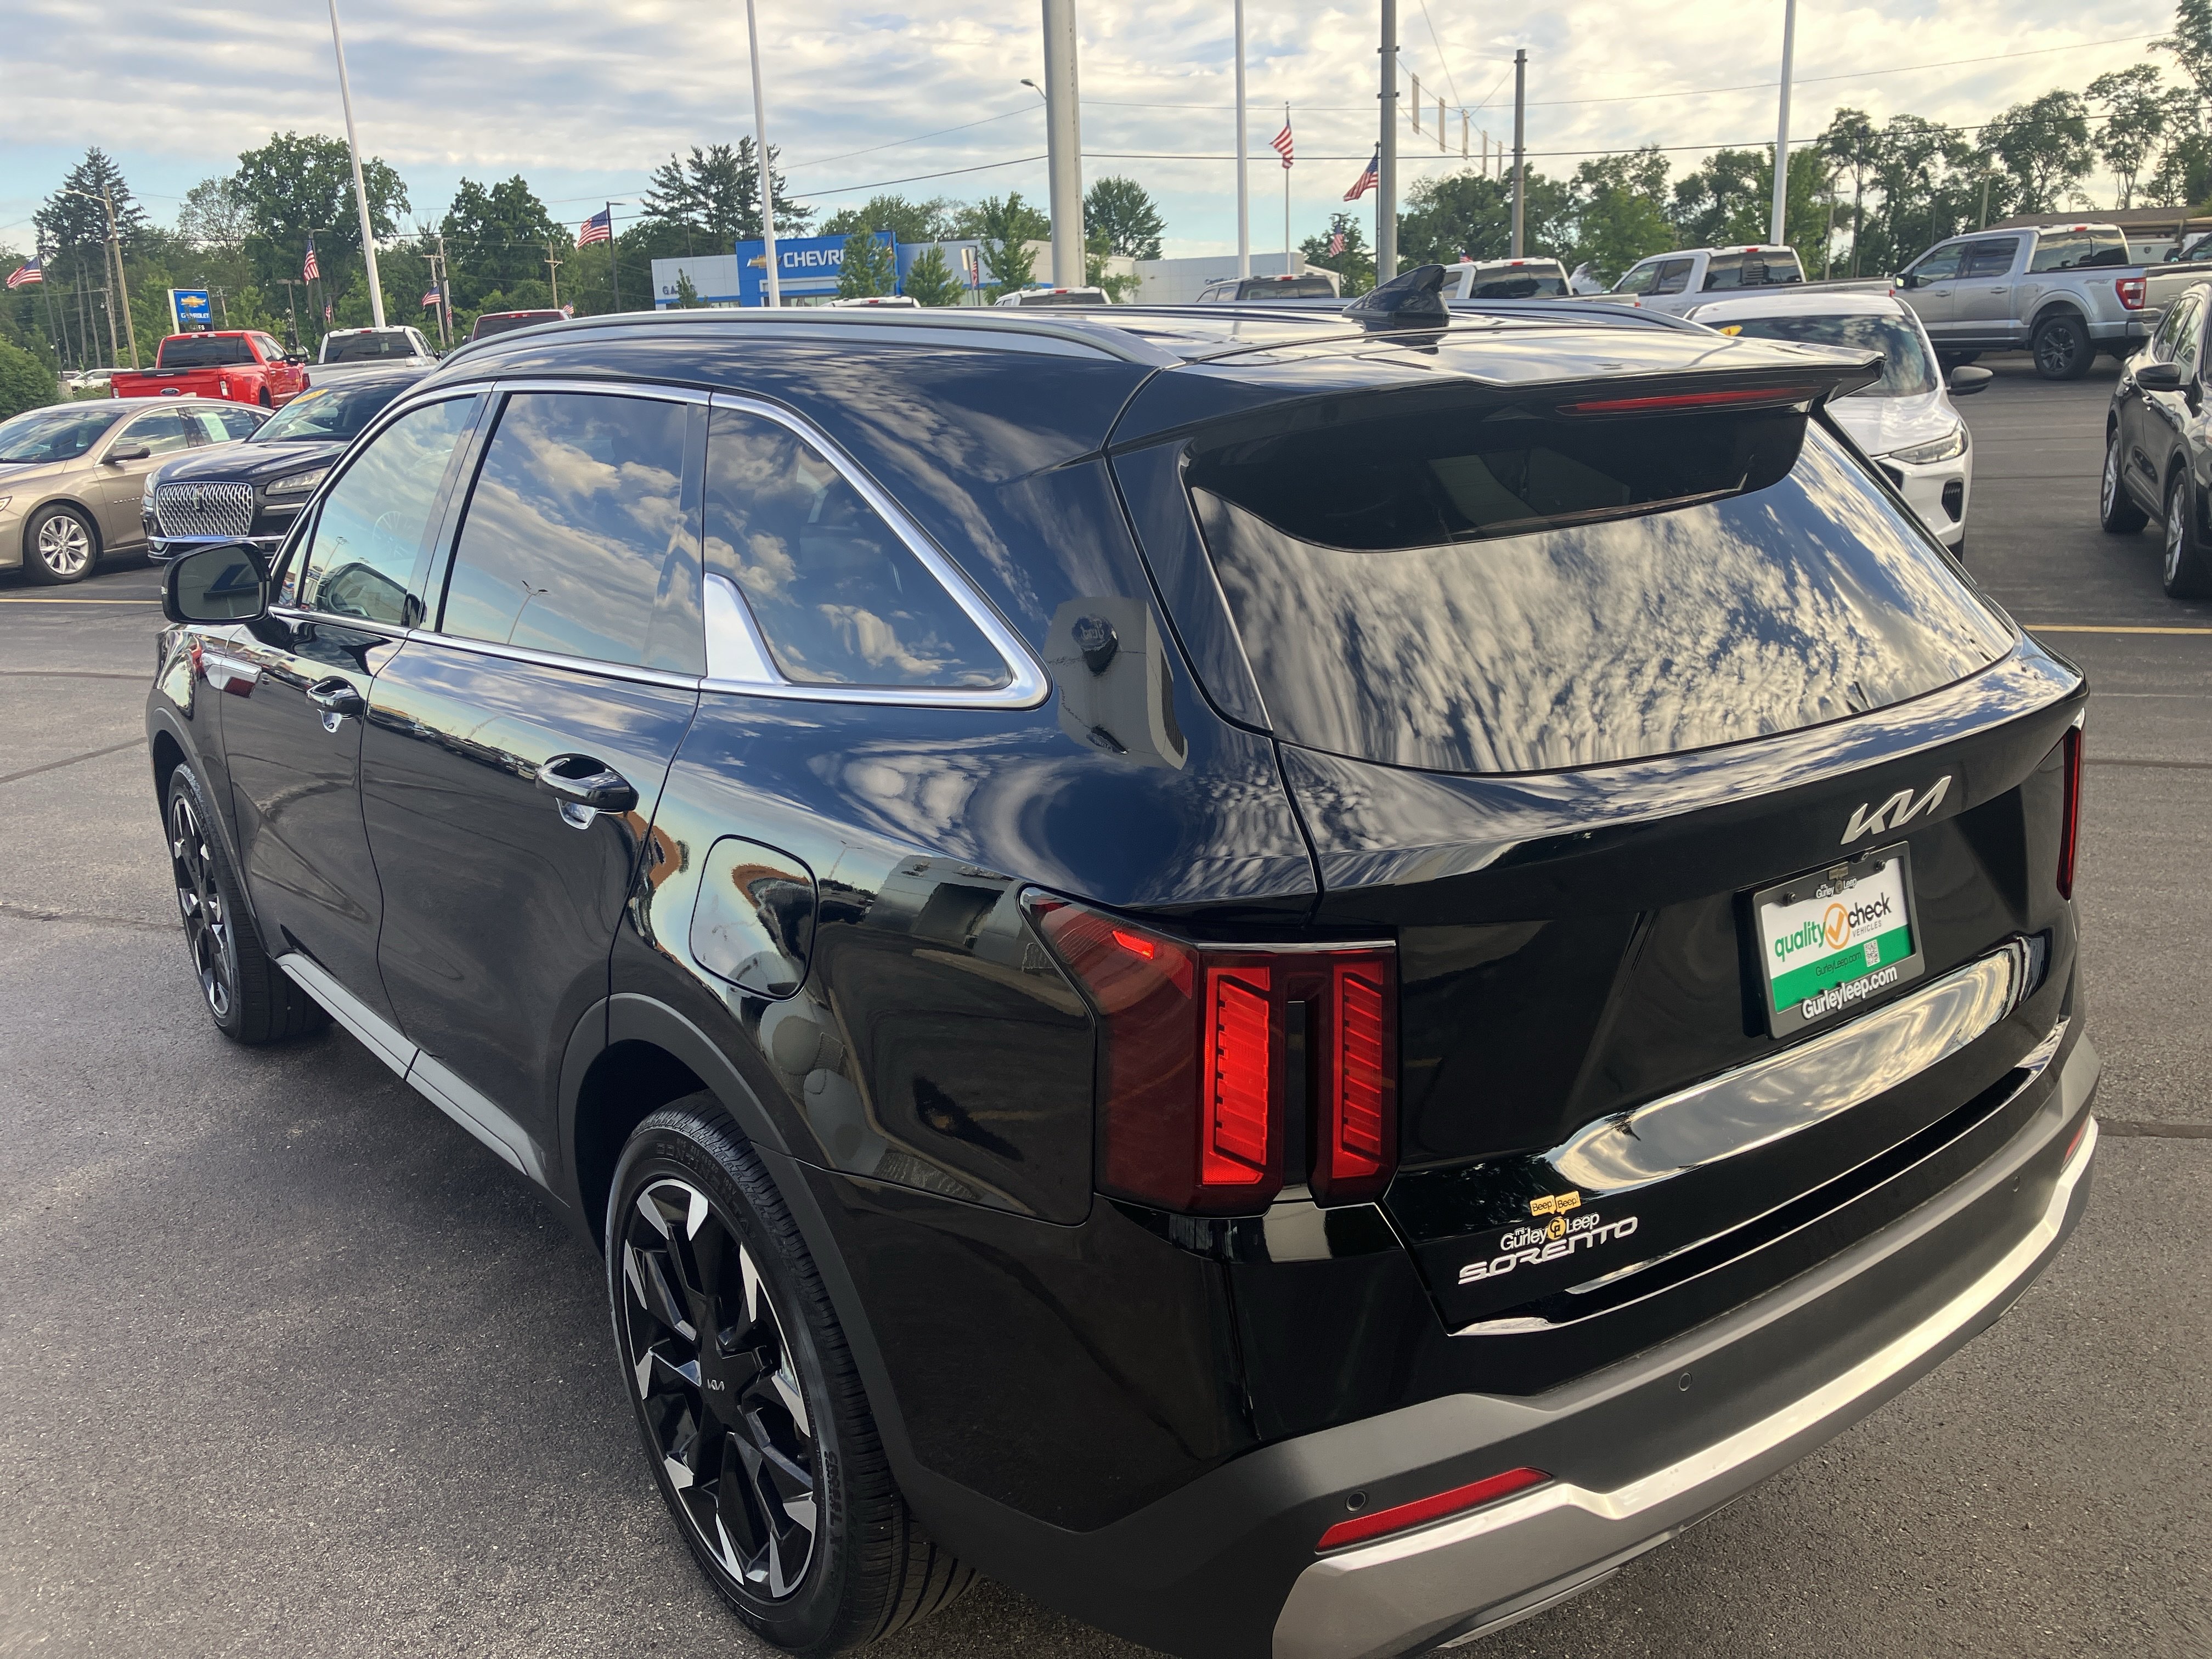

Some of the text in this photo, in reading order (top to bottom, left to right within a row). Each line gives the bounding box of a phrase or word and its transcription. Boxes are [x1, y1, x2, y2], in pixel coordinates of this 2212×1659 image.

[1840, 775, 1952, 845] KIA
[1816, 878, 1857, 899] Gurley Leep
[1774, 891, 1892, 962] quality check
[1852, 919, 1882, 938] VEHICLES
[1815, 952, 1862, 977] GurleyLeep.com
[1802, 966, 1898, 1019] Gurleyleep.com
[1532, 1194, 1579, 1212] Beep! Beep!
[1500, 1227, 1548, 1251] Gurley
[1566, 1213, 1600, 1234] Leep
[1458, 1216, 1638, 1285] SORENTO
[707, 1379, 725, 1392] KIA
